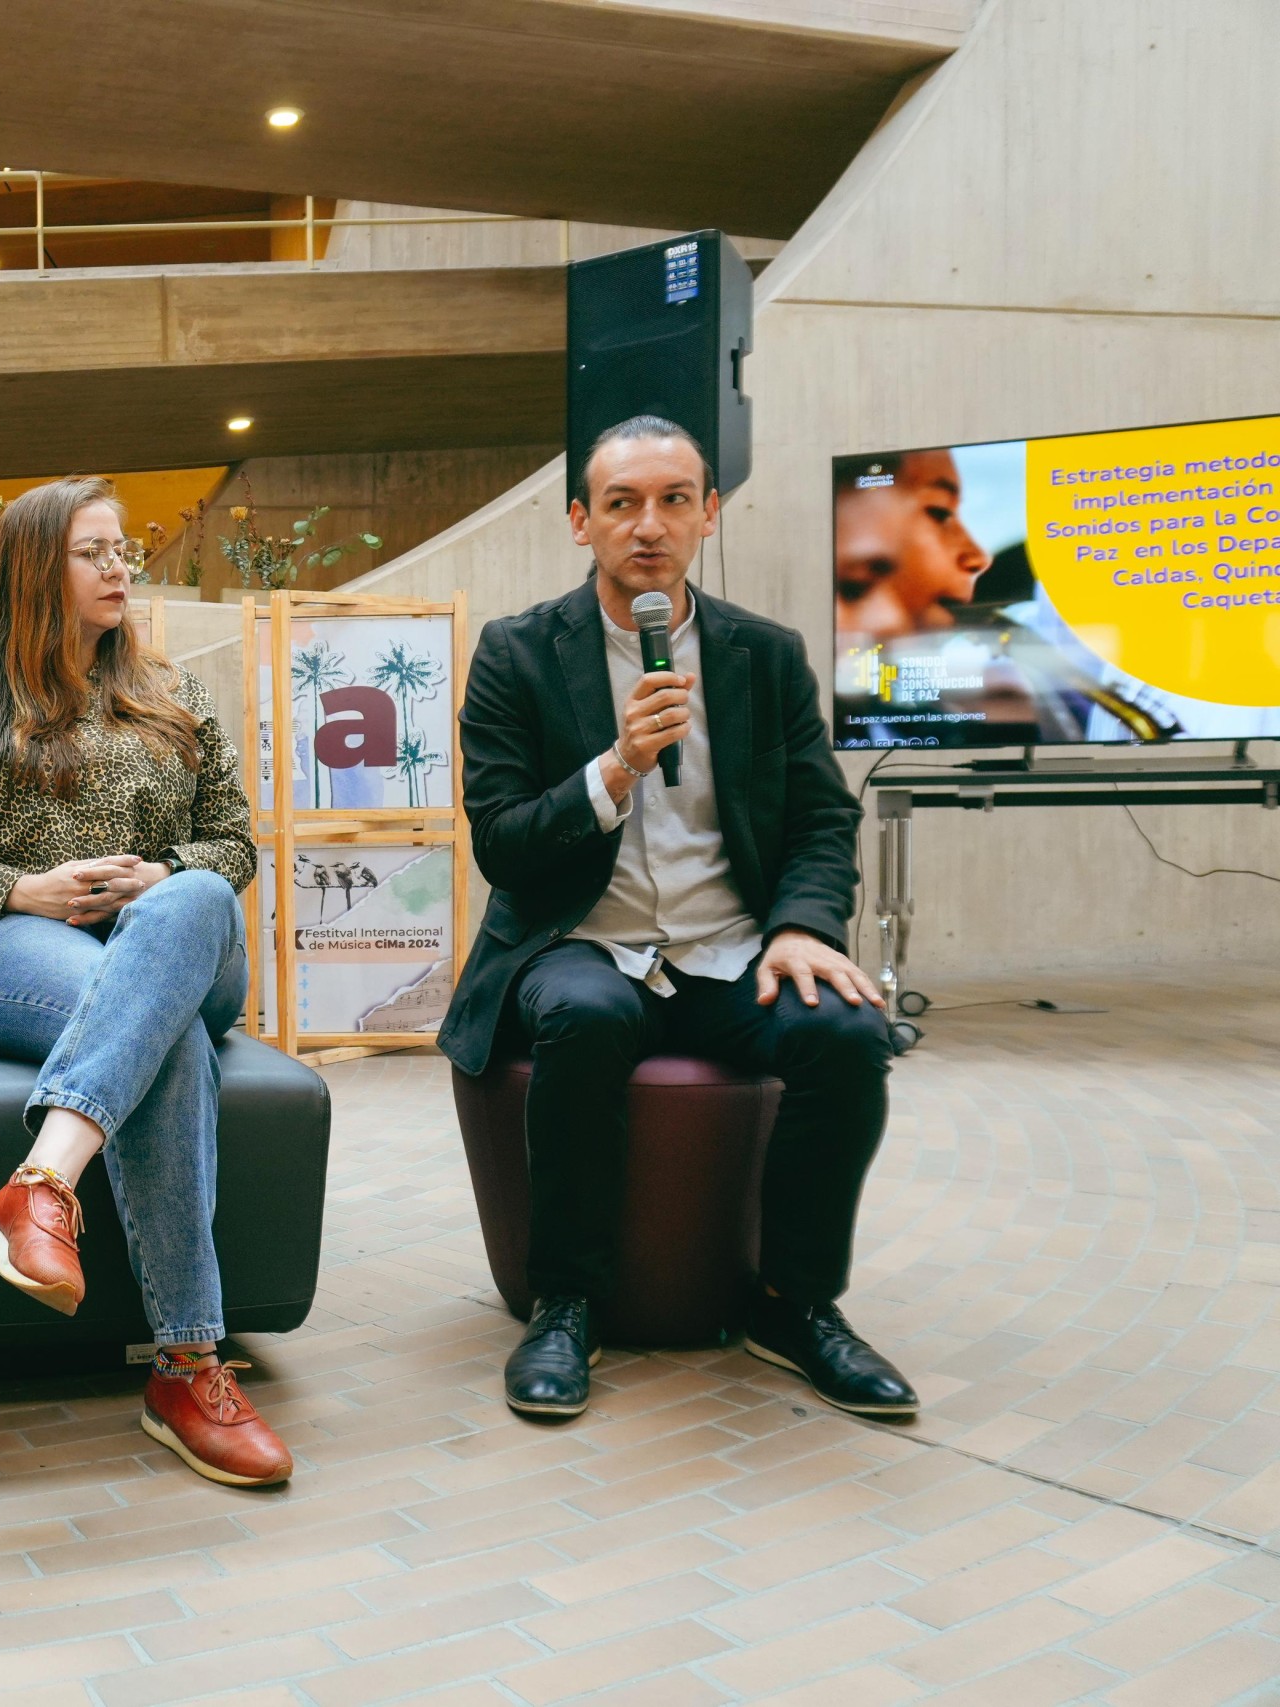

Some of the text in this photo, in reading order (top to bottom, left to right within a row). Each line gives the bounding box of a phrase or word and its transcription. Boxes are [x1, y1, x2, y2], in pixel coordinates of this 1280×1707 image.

[1051, 451, 1280, 485] Estrategia metodo
[860, 479, 894, 487] Colombia
[1073, 479, 1273, 511] implementación
[1046, 507, 1280, 538] Sonidos para la Co
[1076, 546, 1119, 562] Paz
[1135, 545, 1163, 558] en
[1172, 540, 1209, 556] los
[1113, 567, 1204, 586] Caldas,
[901, 656, 946, 668] SONIDOS
[901, 667, 948, 679] PARA LA
[901, 675, 983, 690] CONSTRUCCIÓN
[901, 689, 940, 701] DE PAZ
[849, 715, 861, 724] La
[862, 715, 880, 725] paz
[882, 714, 911, 723] suena
[928, 713, 942, 722] las
[944, 712, 986, 724] regiones
[314, 686, 397, 769] a
[305, 926, 443, 939] Festitval Internacional
[309, 939, 440, 950] de Música CiMa 2024
